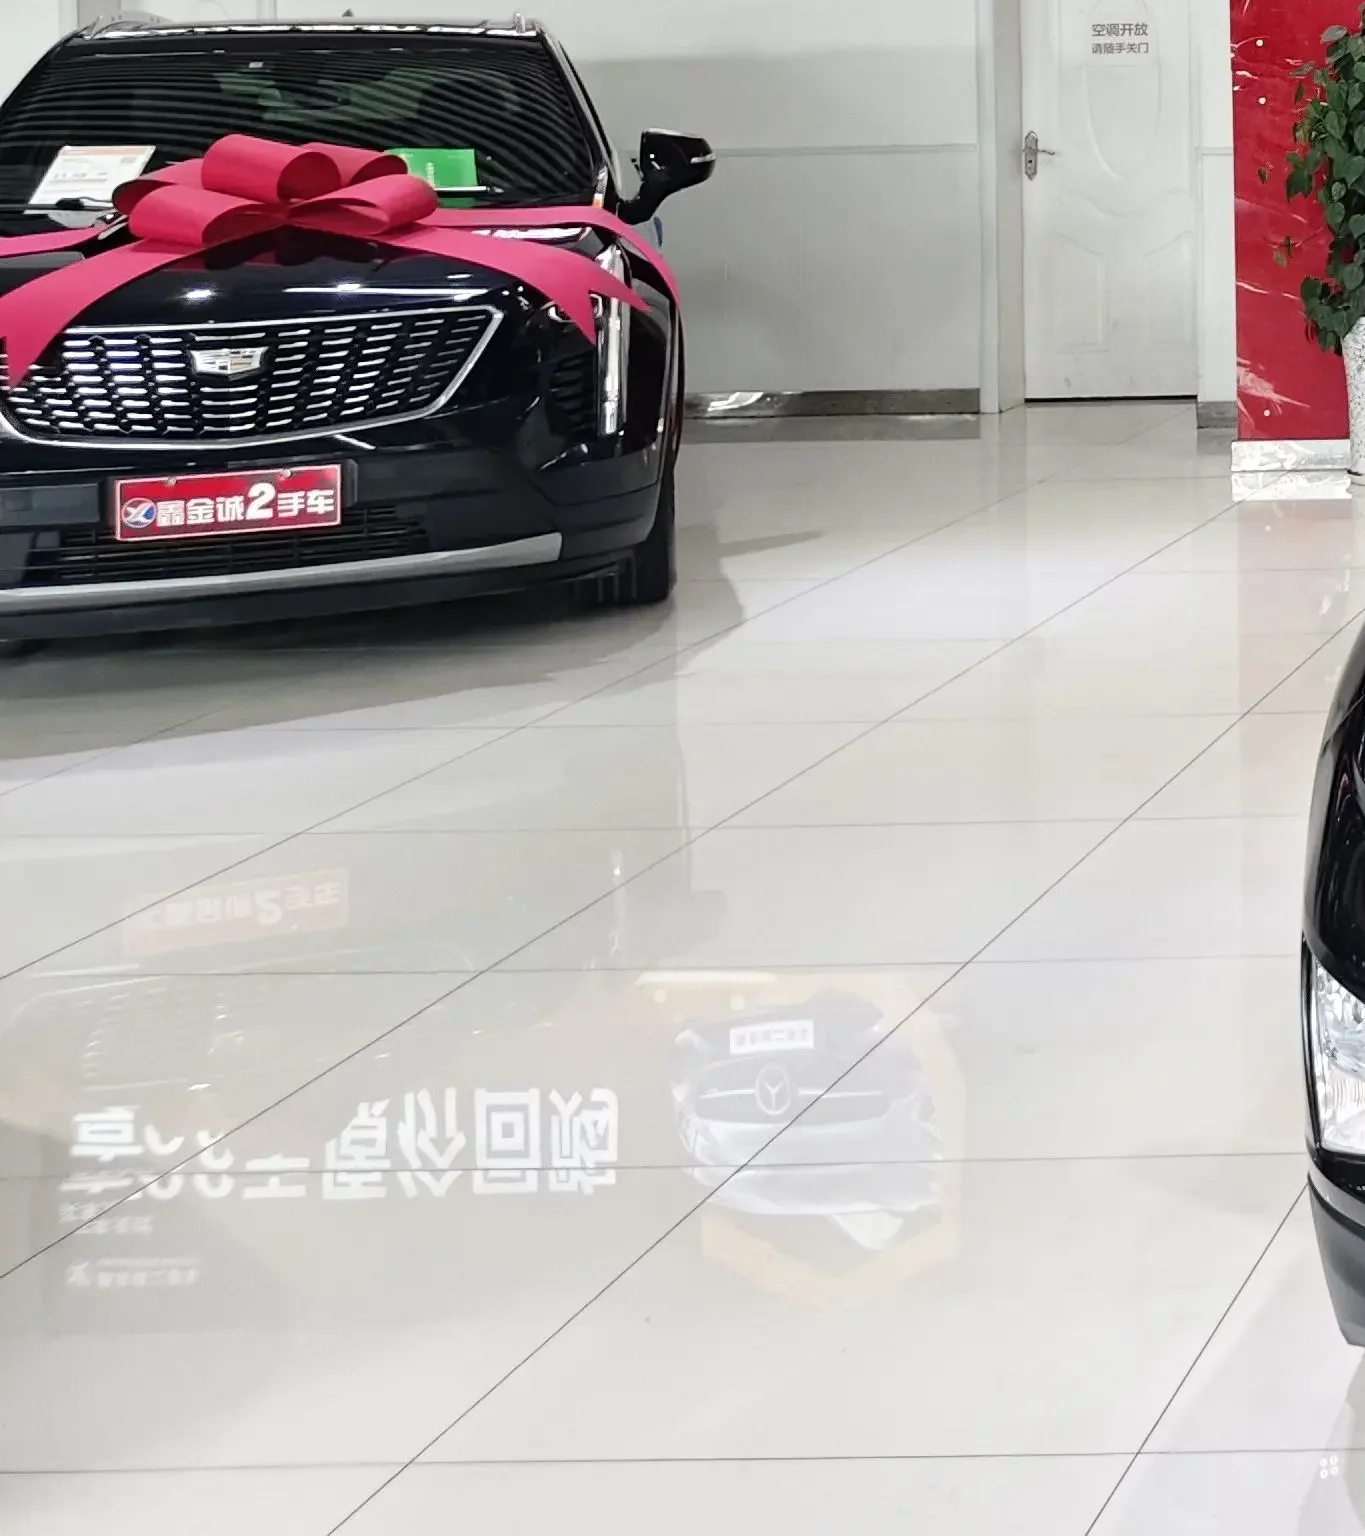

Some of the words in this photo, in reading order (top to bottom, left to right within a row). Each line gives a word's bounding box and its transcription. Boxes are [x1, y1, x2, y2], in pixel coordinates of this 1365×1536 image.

[1091, 23, 1149, 37] 空调开放
[157, 481, 335, 528] 鑫金诚2手车
